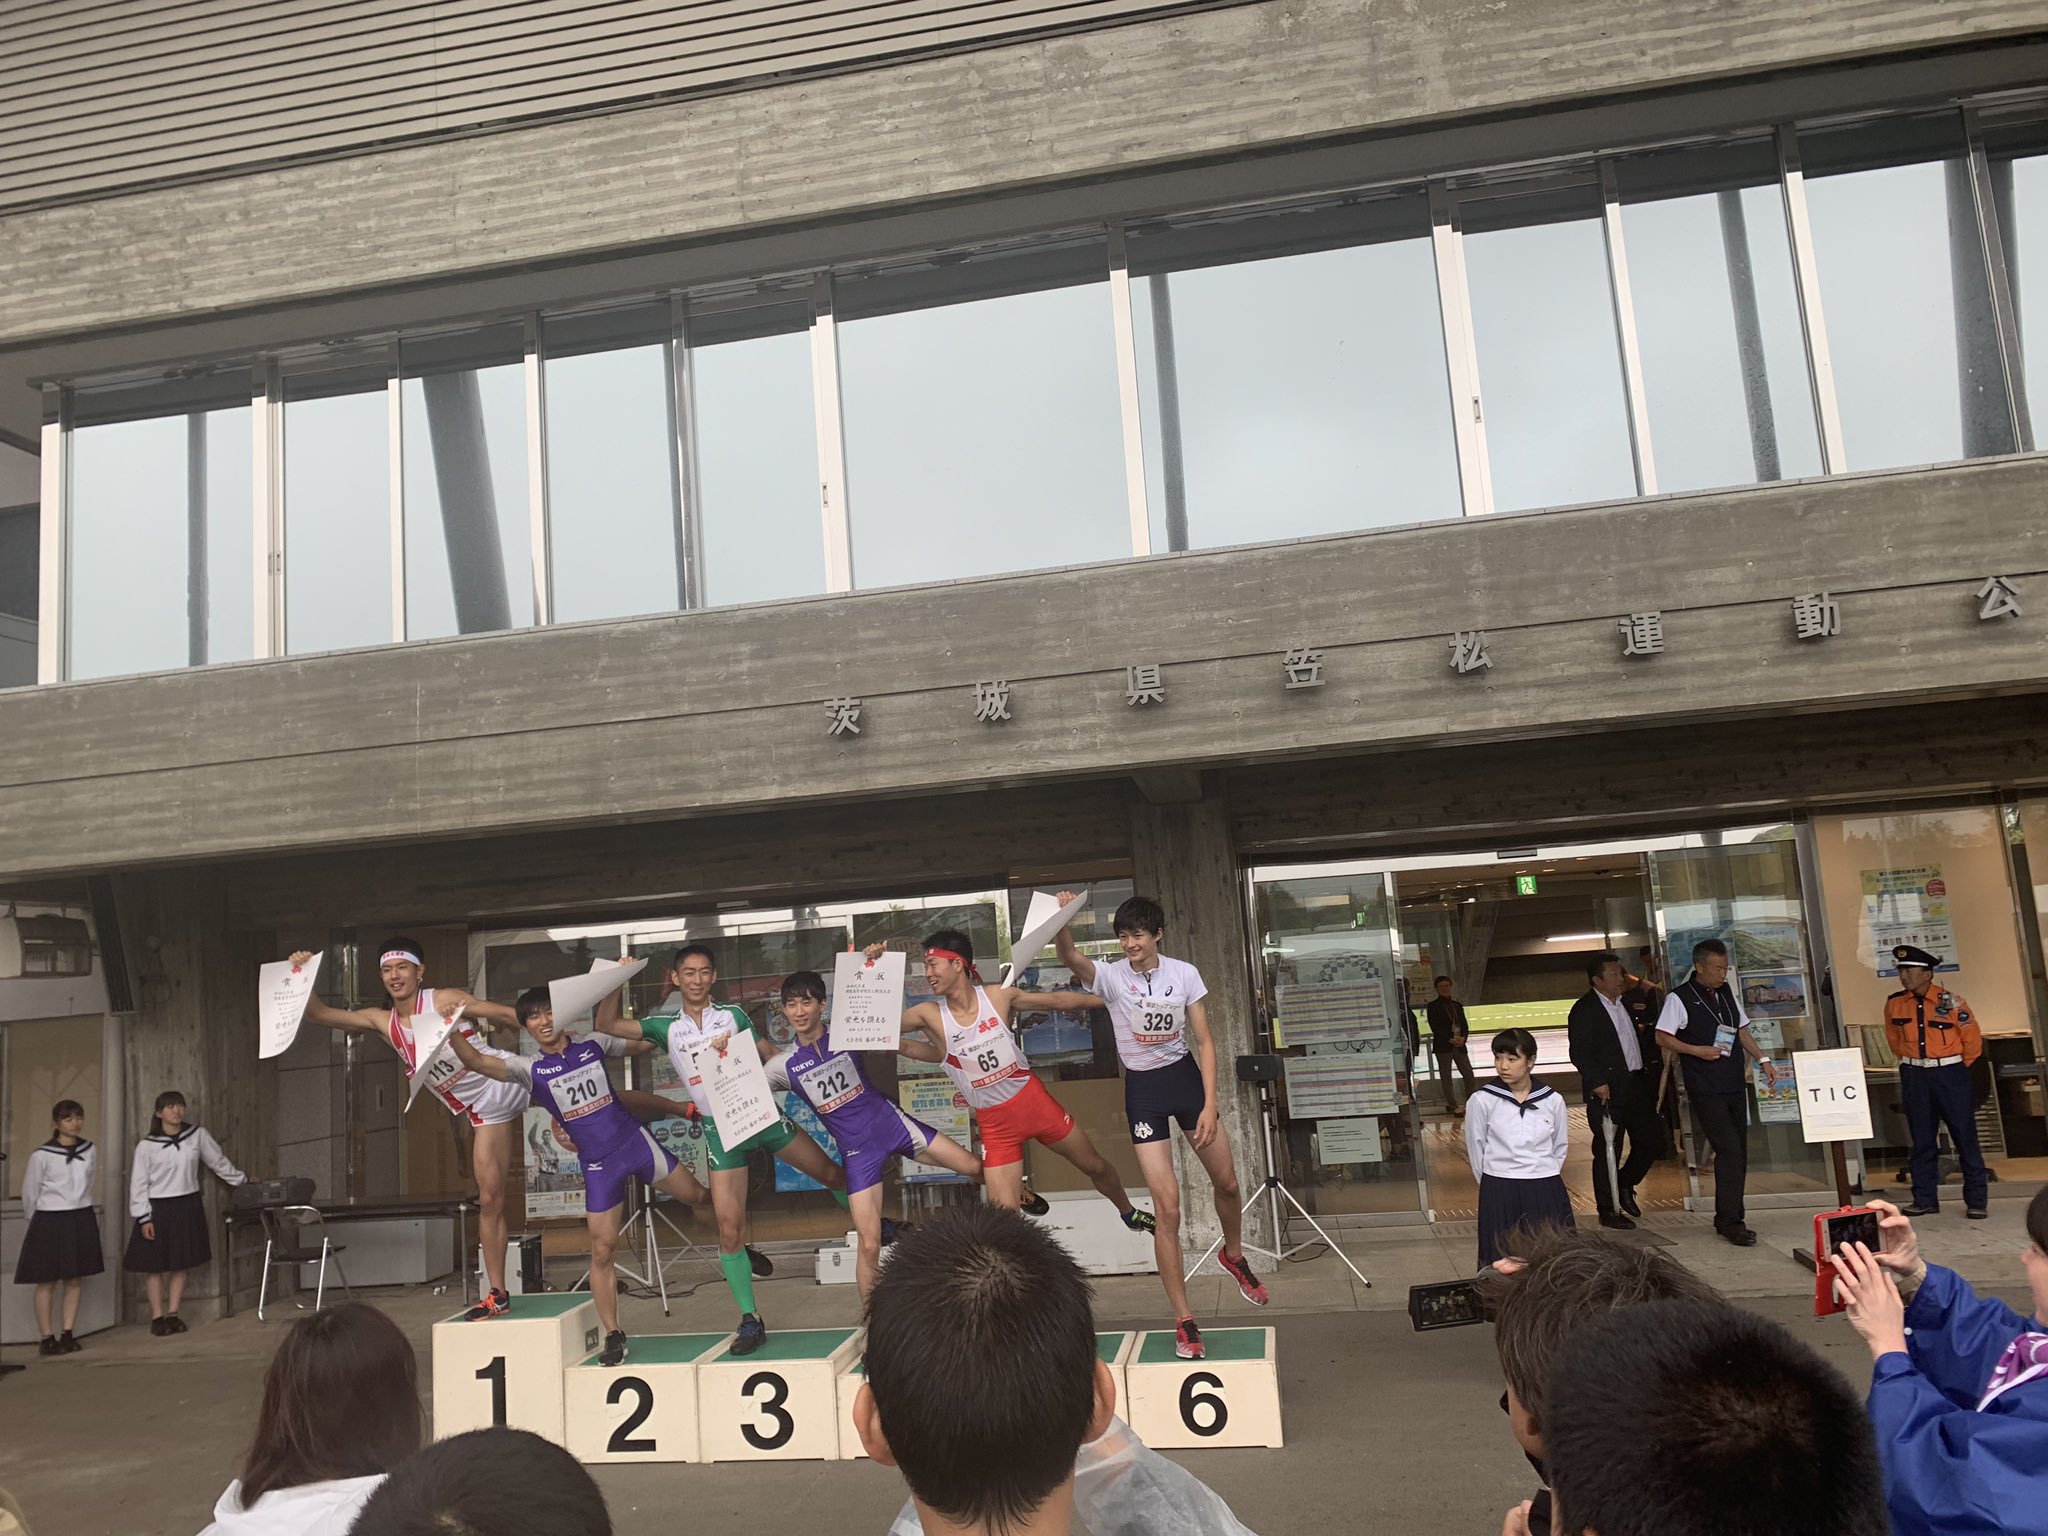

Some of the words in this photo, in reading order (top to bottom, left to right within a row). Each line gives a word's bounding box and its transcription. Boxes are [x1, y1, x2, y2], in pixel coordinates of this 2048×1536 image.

[978, 1016, 999, 1033] 武田
[1143, 1012, 1173, 1032] 329
[428, 1059, 455, 1081] 113
[536, 1065, 562, 1075] TOKYO
[791, 1060, 815, 1073] TOKYO
[977, 1050, 999, 1073] 65
[567, 1079, 597, 1106] 210
[817, 1071, 850, 1100] 212
[475, 1356, 507, 1428] 1
[1179, 1371, 1228, 1437] 6
[606, 1376, 657, 1453] 2
[740, 1371, 795, 1451] 3
